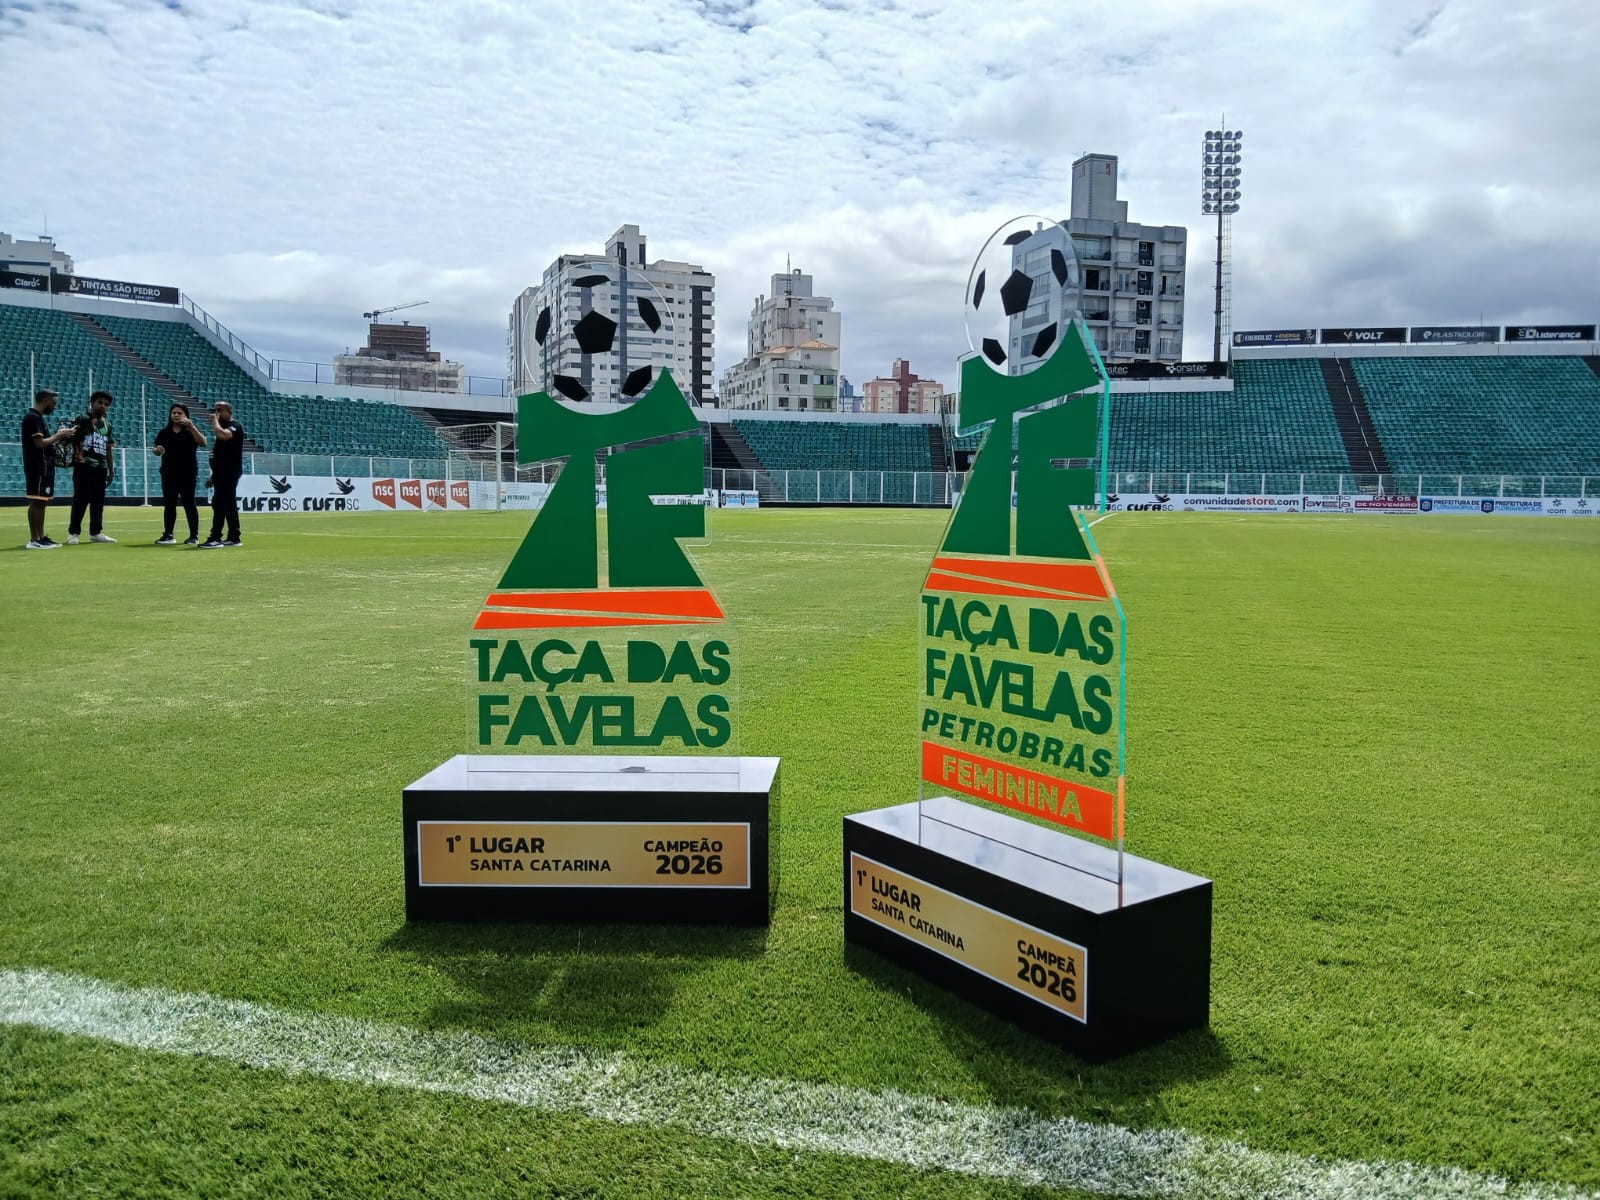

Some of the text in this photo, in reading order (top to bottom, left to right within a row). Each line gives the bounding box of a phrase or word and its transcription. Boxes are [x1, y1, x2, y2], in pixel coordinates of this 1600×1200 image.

[15, 278, 37, 287] Claro
[81, 280, 111, 291] TINTAS
[113, 283, 131, 294] SÃO
[132, 286, 160, 296] PEDRO
[1355, 331, 1384, 340] VOLT
[1176, 363, 1207, 372] orsitec
[374, 485, 394, 496] nsc
[402, 486, 420, 496] nsc
[428, 486, 445, 496] nsc
[452, 487, 468, 497] nsc
[1184, 497, 1299, 506] comunidadestore.com
[922, 595, 1114, 665] TAÇA DAS
[470, 639, 731, 692] TAÇA DAS
[926, 648, 1113, 735] FAVELAS
[479, 694, 731, 748] FAVELAS
[922, 708, 1113, 777] PETROBRAS
[943, 754, 1083, 822] FEMININA
[470, 837, 545, 853] LUGAR
[643, 838, 723, 852] CAMPEÃO
[470, 859, 611, 872] SANTA CATARINA
[656, 855, 723, 875] 2026
[871, 875, 921, 912] LUGAR
[871, 897, 965, 951] SANTA CATARINA
[1017, 939, 1077, 977] CAMPEÃ
[1017, 957, 1077, 1003] 2026
